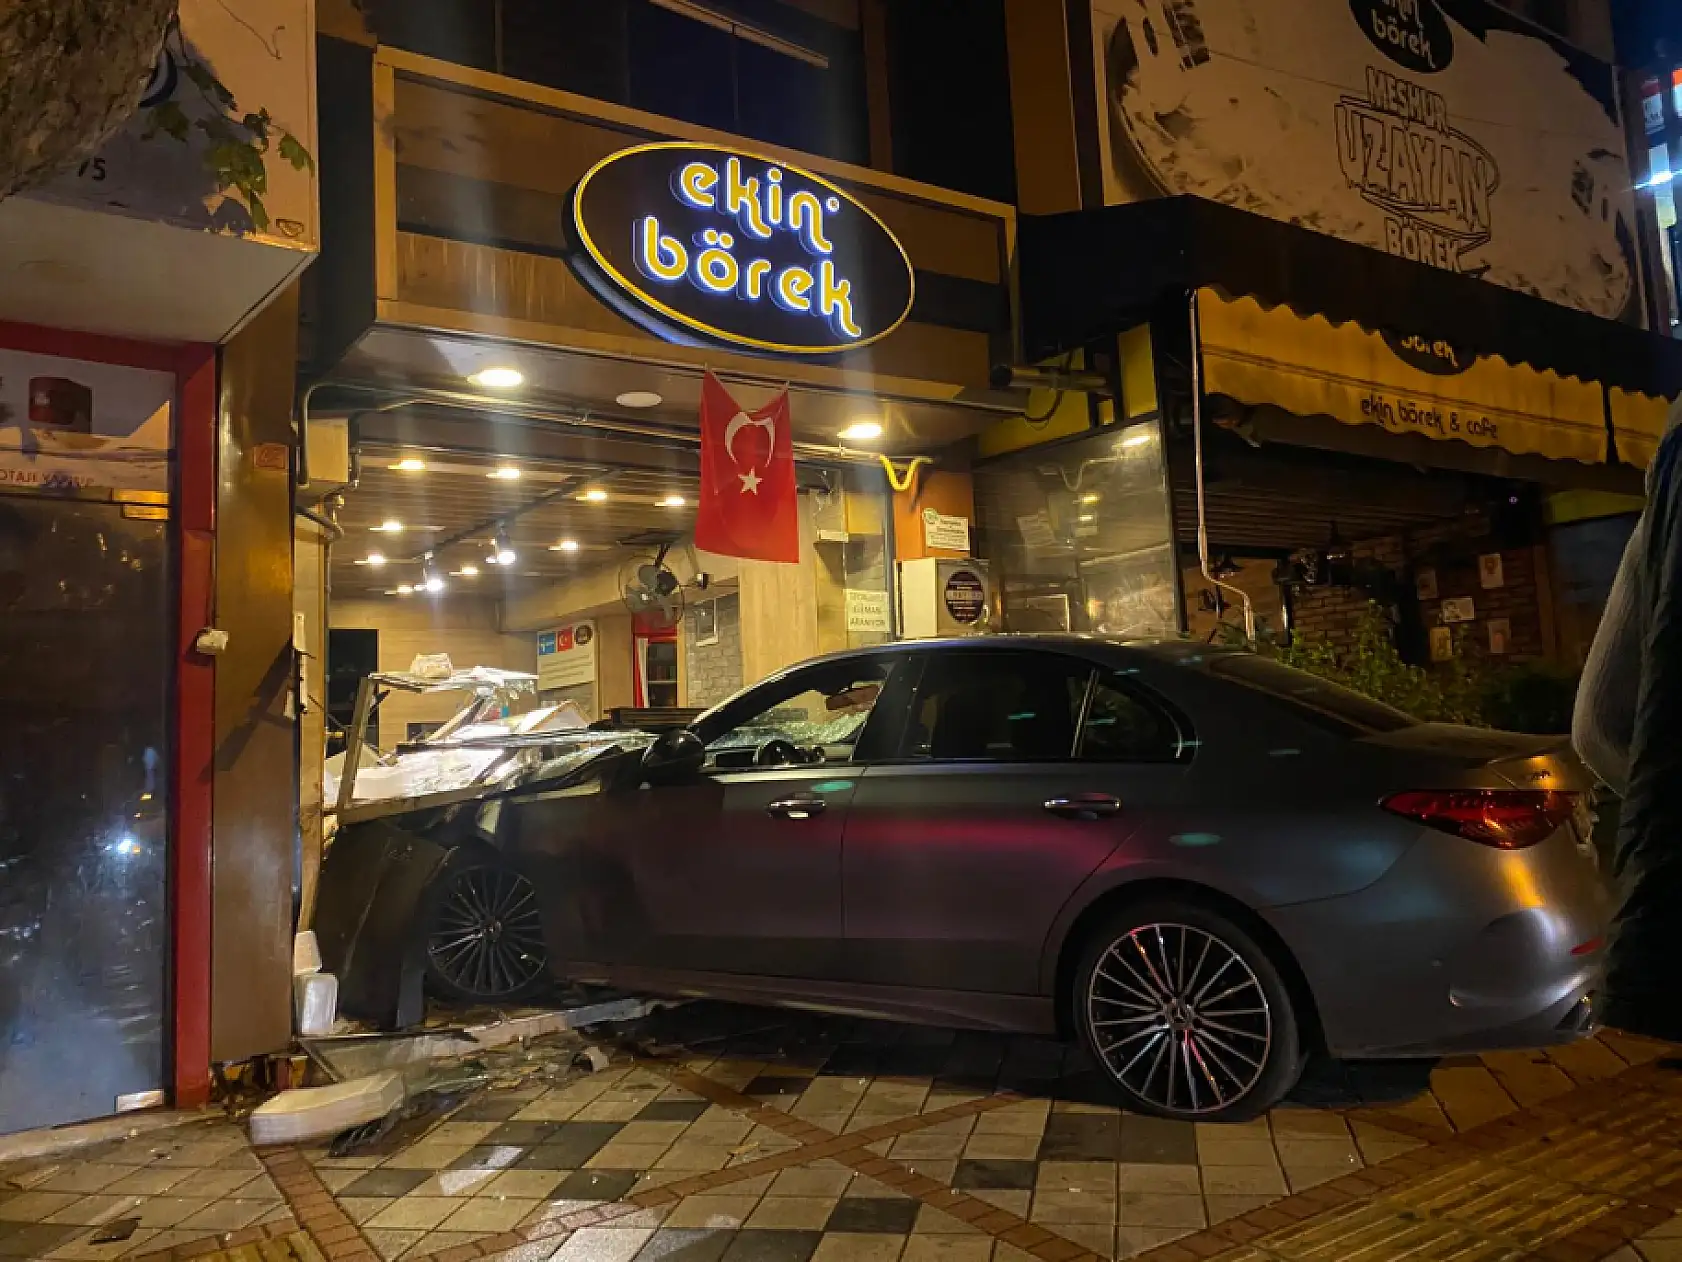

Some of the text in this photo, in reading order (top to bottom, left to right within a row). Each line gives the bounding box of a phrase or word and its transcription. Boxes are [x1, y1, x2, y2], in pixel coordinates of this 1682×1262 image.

[1371, 8, 1437, 69] börek
[679, 155, 833, 254] ekin
[1334, 103, 1492, 232] UZAYAN
[641, 214, 863, 339] börek
[1361, 390, 1398, 426] ekin
[1398, 399, 1447, 436] börek
